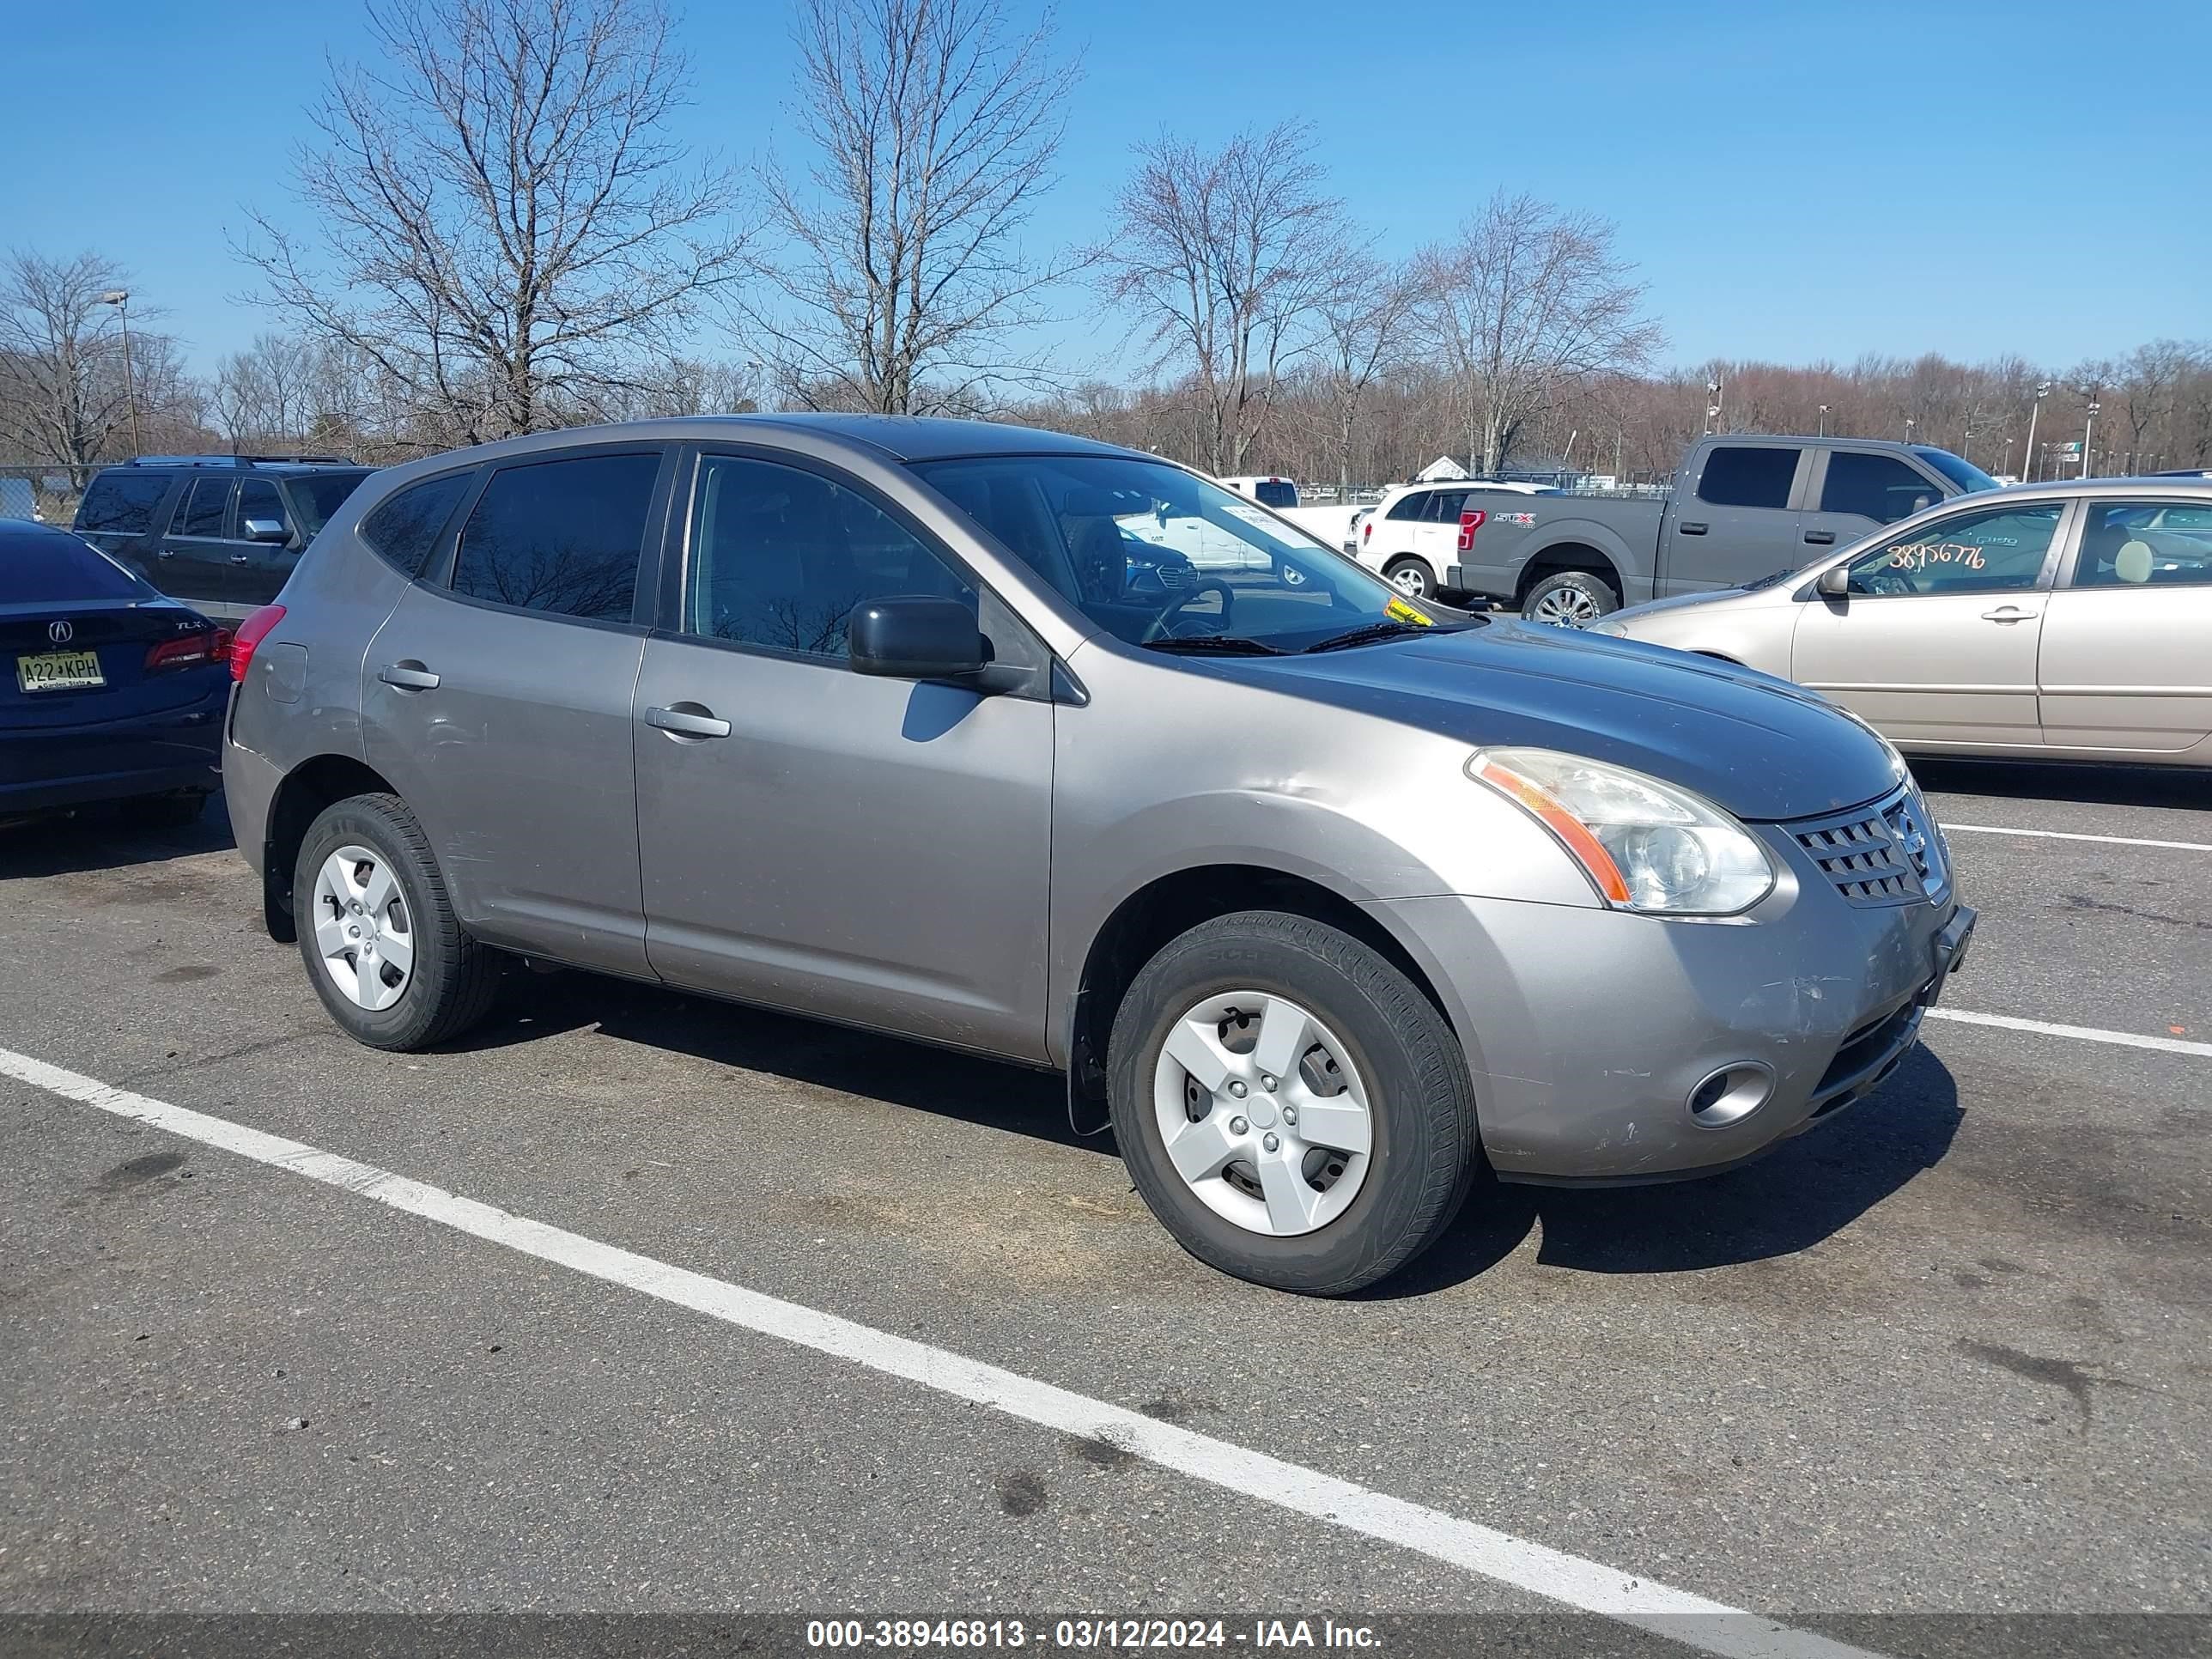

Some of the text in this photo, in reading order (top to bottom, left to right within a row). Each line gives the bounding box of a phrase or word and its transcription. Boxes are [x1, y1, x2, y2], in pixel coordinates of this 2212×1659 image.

[1493, 512, 1537, 524] STX
[1887, 544, 1986, 569] 38956776
[175, 621, 201, 630] TLX
